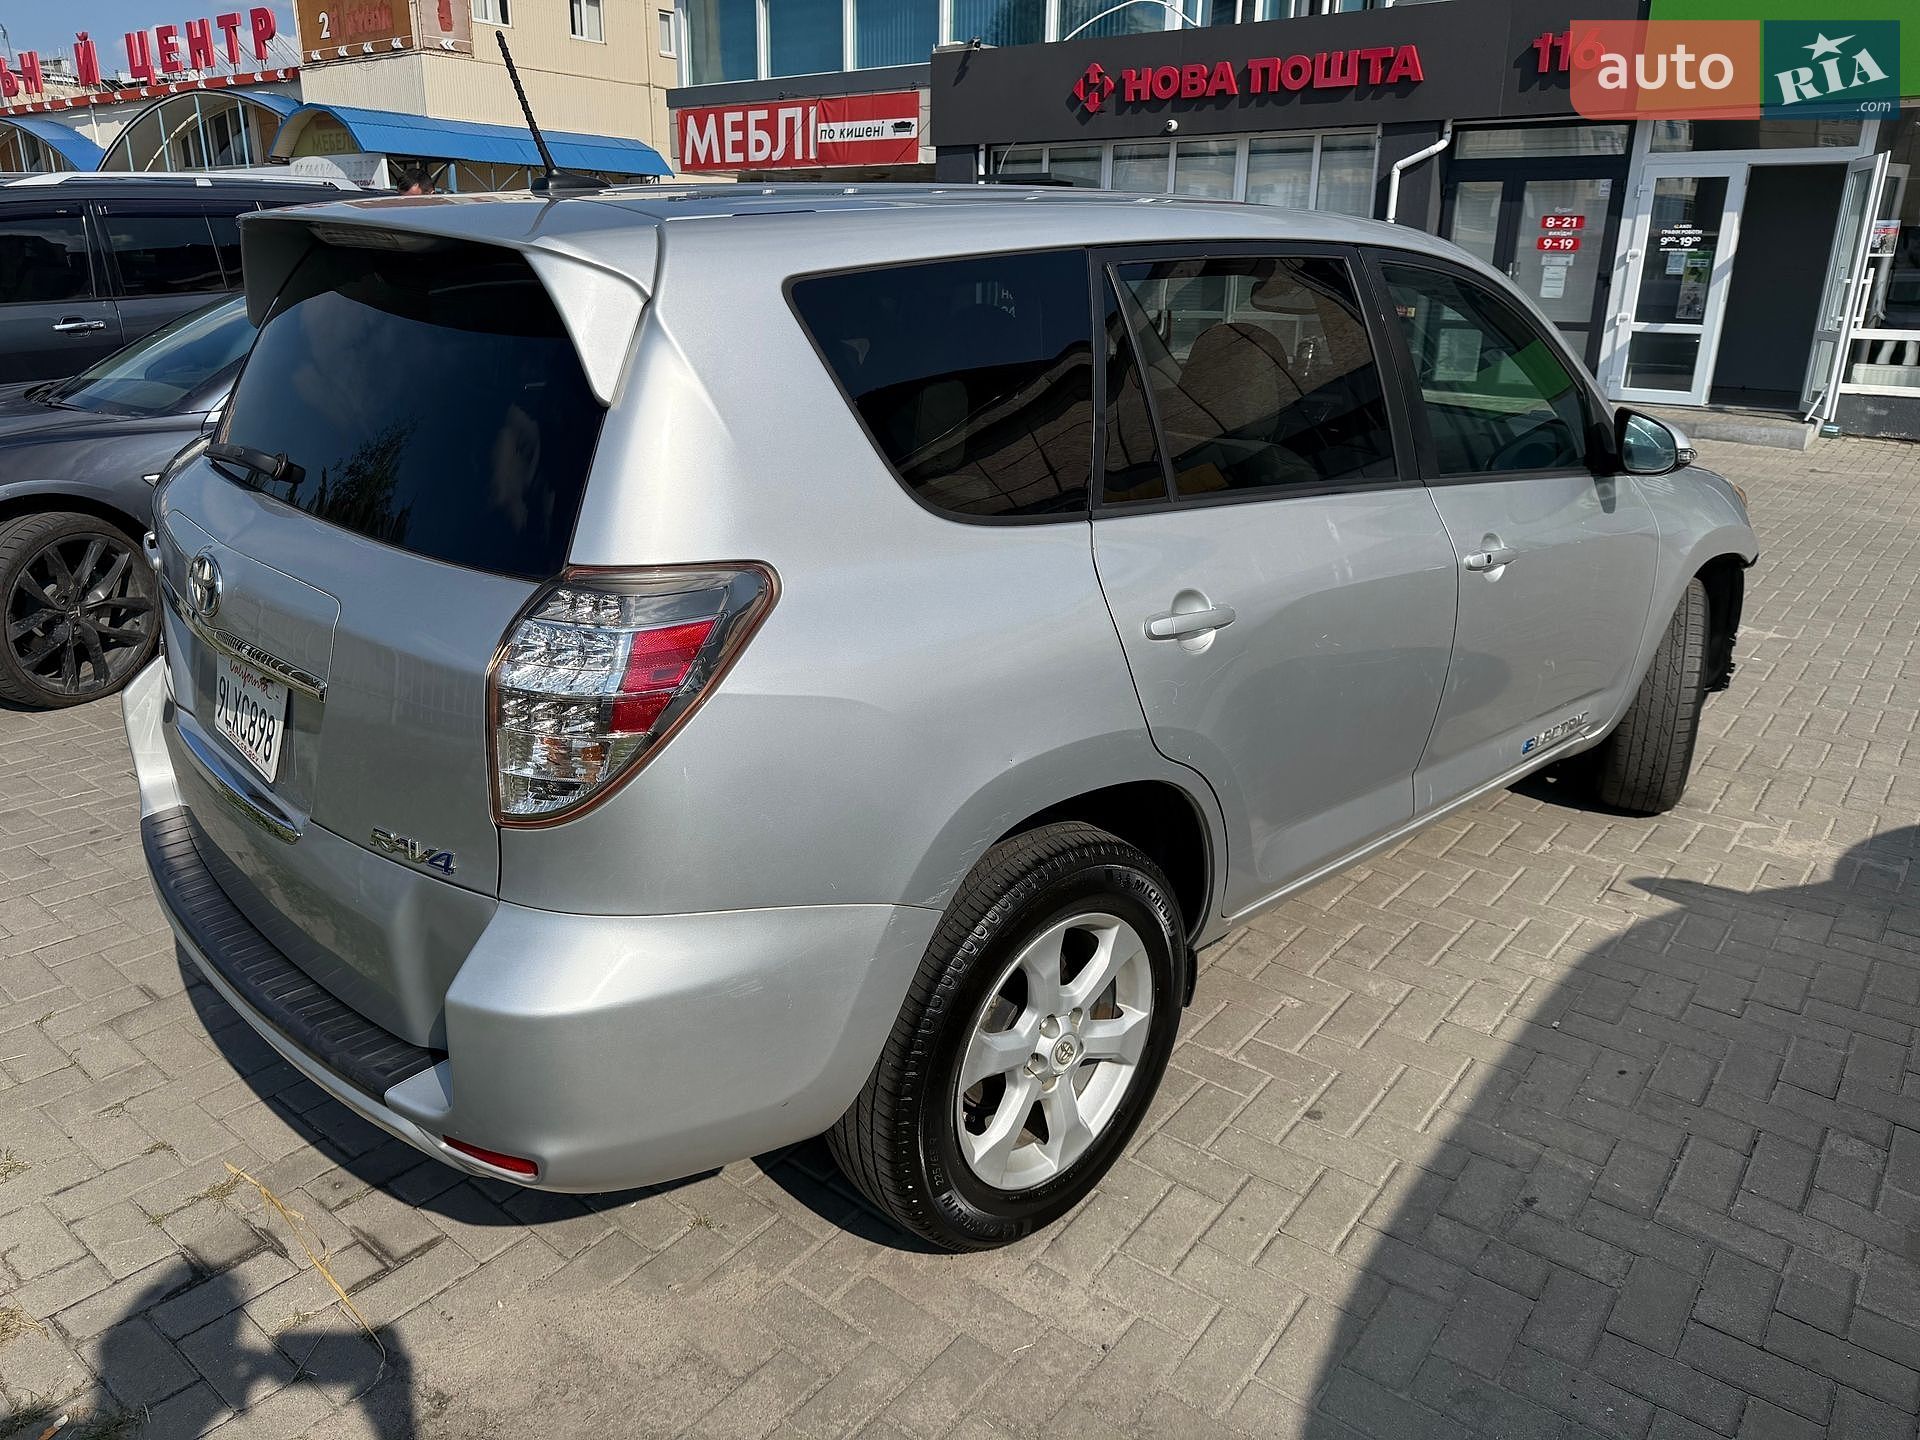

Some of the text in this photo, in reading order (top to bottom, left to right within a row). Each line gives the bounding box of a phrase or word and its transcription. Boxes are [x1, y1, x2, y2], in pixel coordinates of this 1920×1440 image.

[124, 7, 276, 87] ЦЕНТР
[1122, 44, 1424, 102] НОВА ПОШТА
[684, 106, 818, 165] МЕБЛІ
[819, 121, 885, 140] по кишені
[1543, 239, 1574, 250] 9-19
[1546, 217, 1577, 228] 8-21
[217, 676, 276, 763] 9LXC898
[369, 825, 457, 876] RAV4
[1132, 878, 1176, 937] MICHELIN
